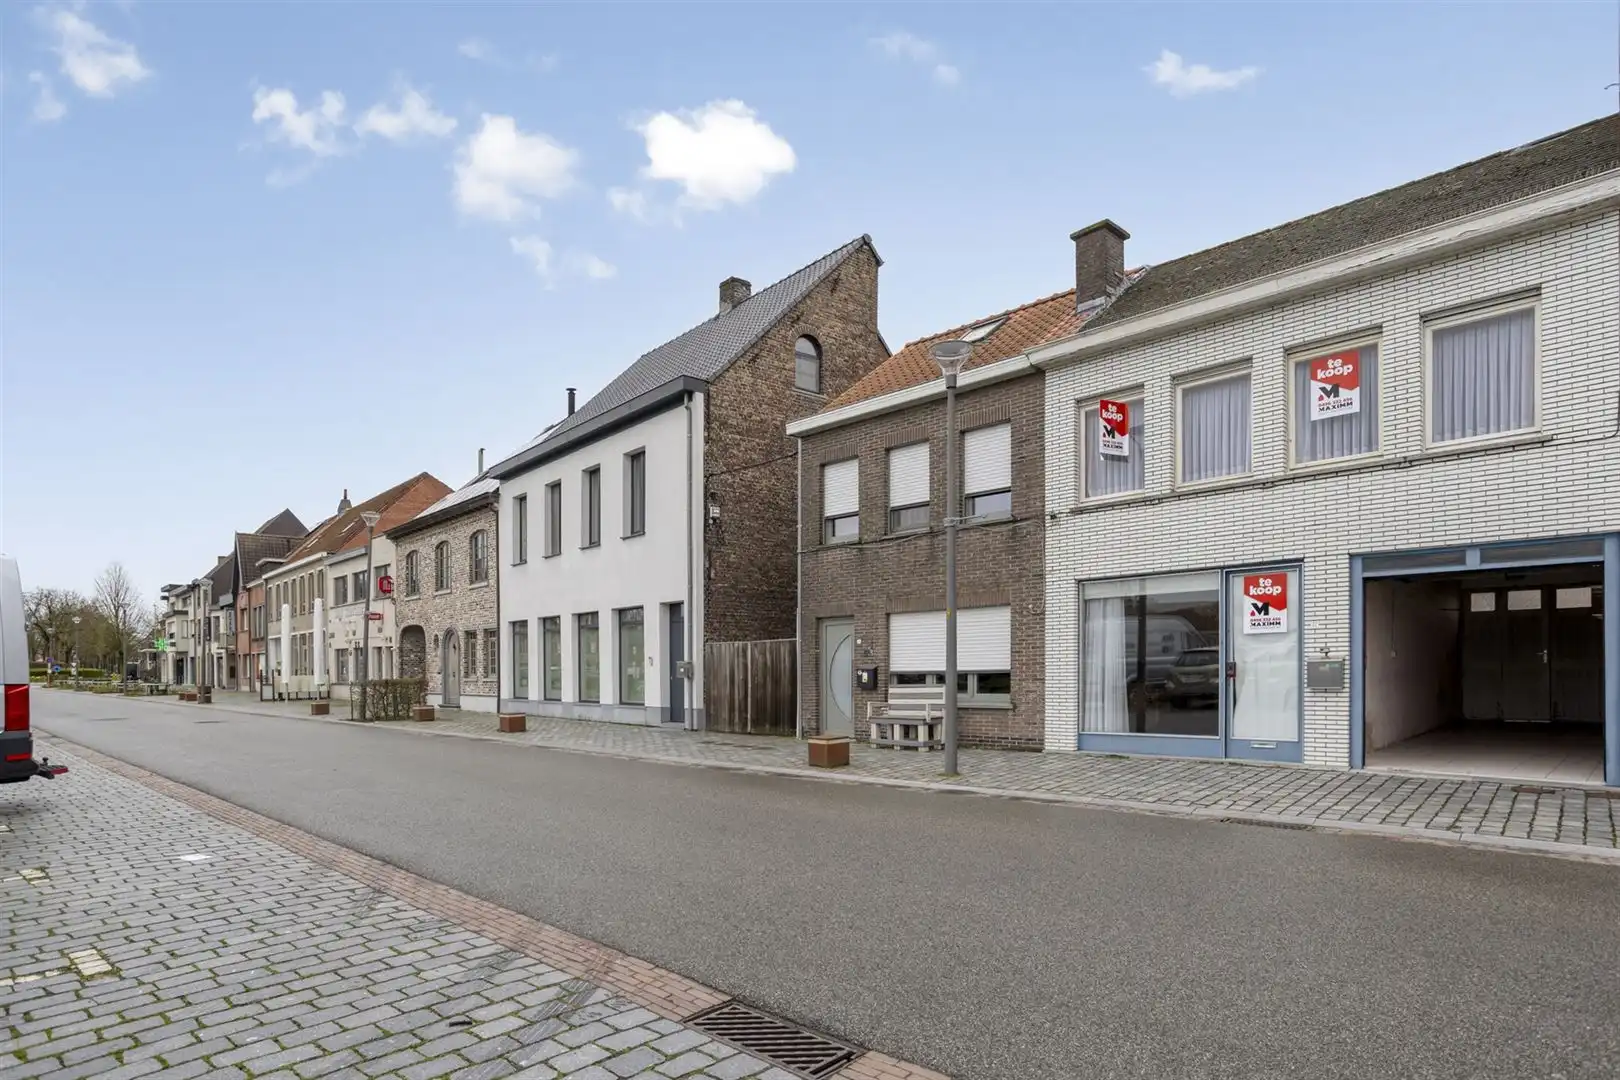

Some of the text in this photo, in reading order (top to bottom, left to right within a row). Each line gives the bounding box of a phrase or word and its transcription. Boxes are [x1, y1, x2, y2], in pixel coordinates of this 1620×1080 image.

[1328, 358, 1342, 368] te
[1317, 364, 1354, 380] koop
[1108, 404, 1117, 412] te
[1318, 402, 1353, 412] MAXIMM
[1102, 409, 1123, 422] koop
[1259, 578, 1272, 586] te
[1249, 586, 1282, 596] koop
